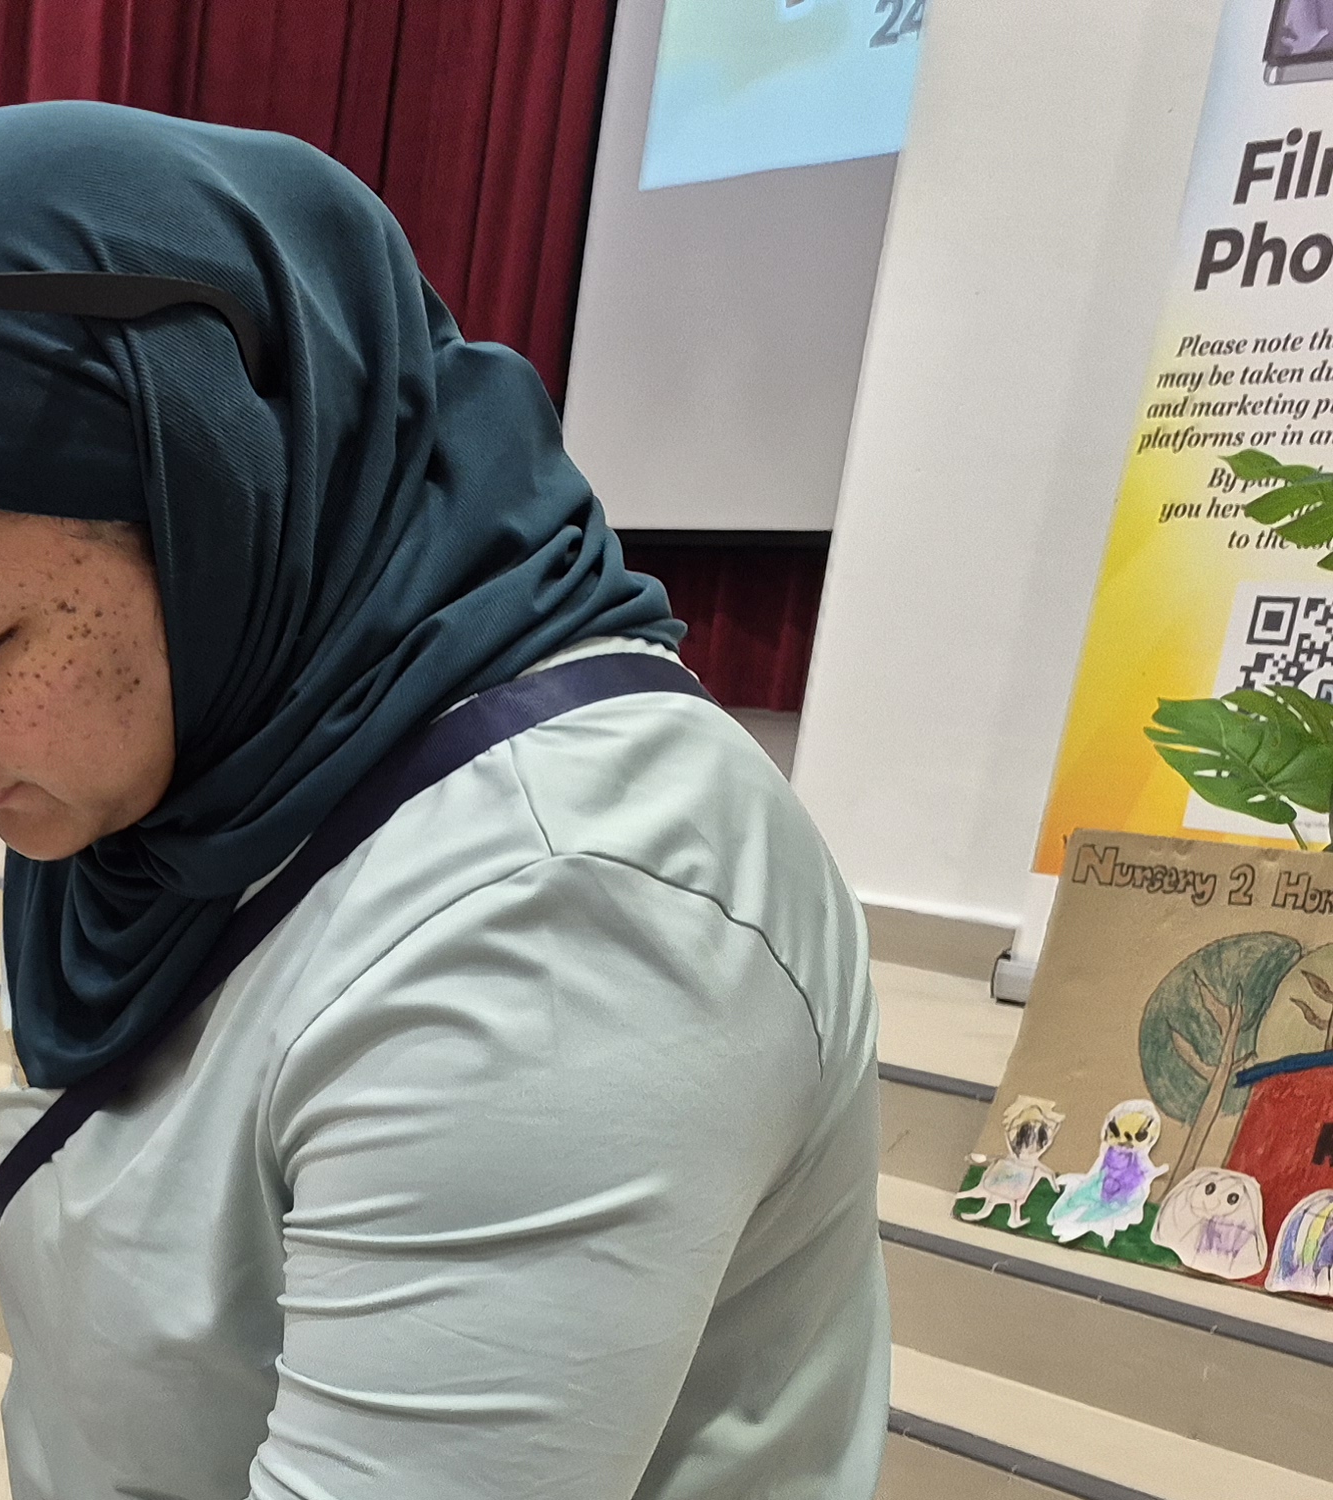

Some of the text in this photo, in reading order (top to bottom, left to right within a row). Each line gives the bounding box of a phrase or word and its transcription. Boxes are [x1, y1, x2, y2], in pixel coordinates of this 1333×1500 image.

[1194, 220, 1333, 292] Pho
[1176, 334, 1248, 358] Please
[1251, 332, 1304, 353] note
[1156, 371, 1204, 393] may
[1208, 364, 1234, 386] be
[1240, 362, 1305, 385] taken
[1146, 396, 1189, 419] and
[1190, 393, 1310, 420] marketing
[1136, 424, 1245, 455] platforms
[1250, 432, 1276, 447] or
[1280, 423, 1304, 446] in
[1207, 467, 1237, 493] By
[1159, 502, 1202, 523] you
[1228, 530, 1250, 549] to
[1072, 844, 1217, 906] Nursery
[1228, 863, 1256, 906] 2
